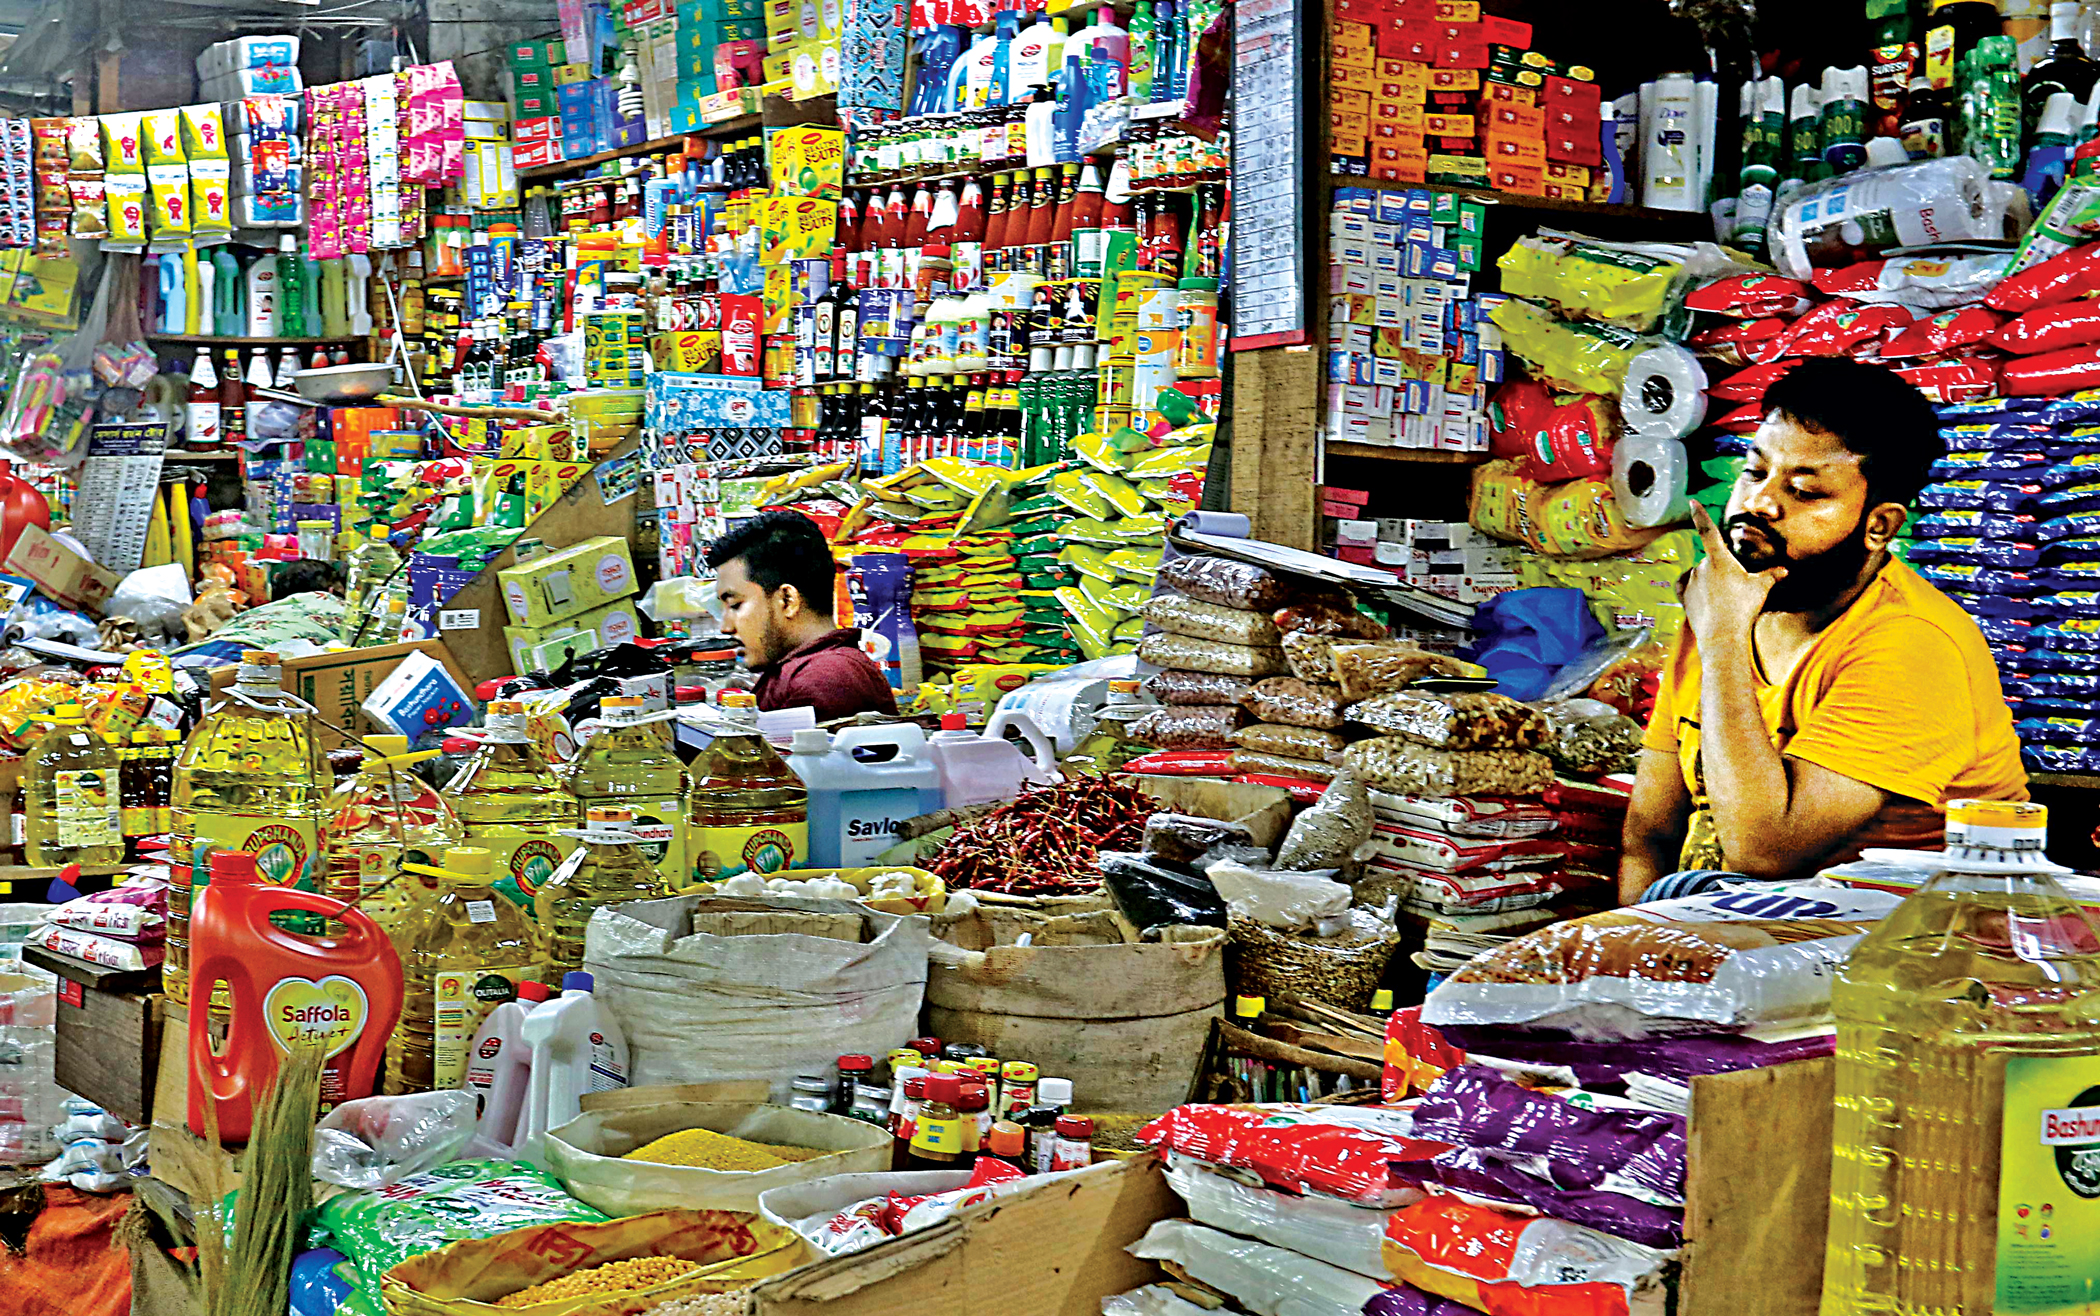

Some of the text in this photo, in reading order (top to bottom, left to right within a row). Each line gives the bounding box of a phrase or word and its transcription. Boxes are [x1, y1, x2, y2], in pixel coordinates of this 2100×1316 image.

[805, 147, 841, 166] SOUPS
[800, 216, 833, 234] SOUPS
[397, 678, 438, 717] Bashundhara
[631, 827, 673, 839] hundhara
[848, 817, 900, 836] Savlo
[475, 988, 511, 998] OLITALIA
[282, 1005, 351, 1023] Saffola
